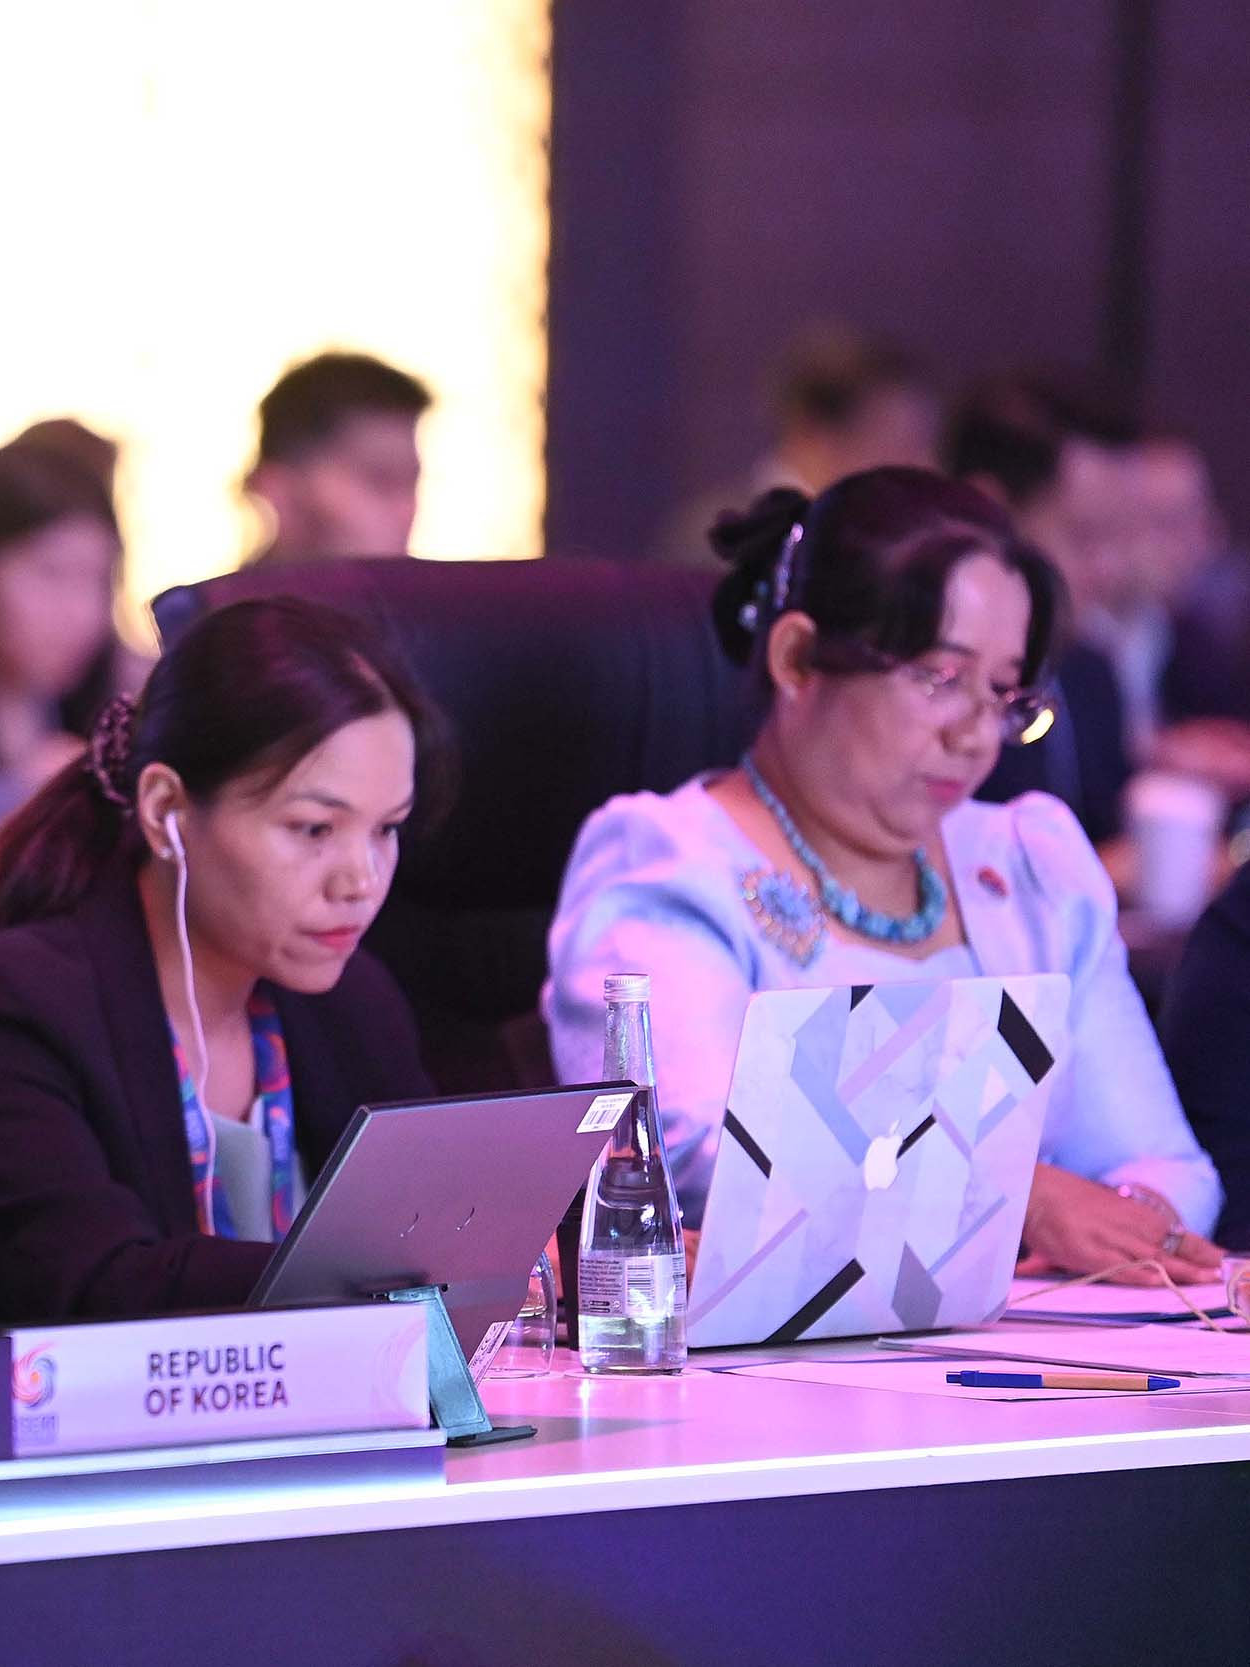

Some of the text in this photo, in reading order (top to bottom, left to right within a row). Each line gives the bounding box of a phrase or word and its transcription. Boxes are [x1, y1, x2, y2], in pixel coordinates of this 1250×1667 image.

[148, 1343, 284, 1379] REPUBLIC
[145, 1380, 289, 1416] OF KOREA
